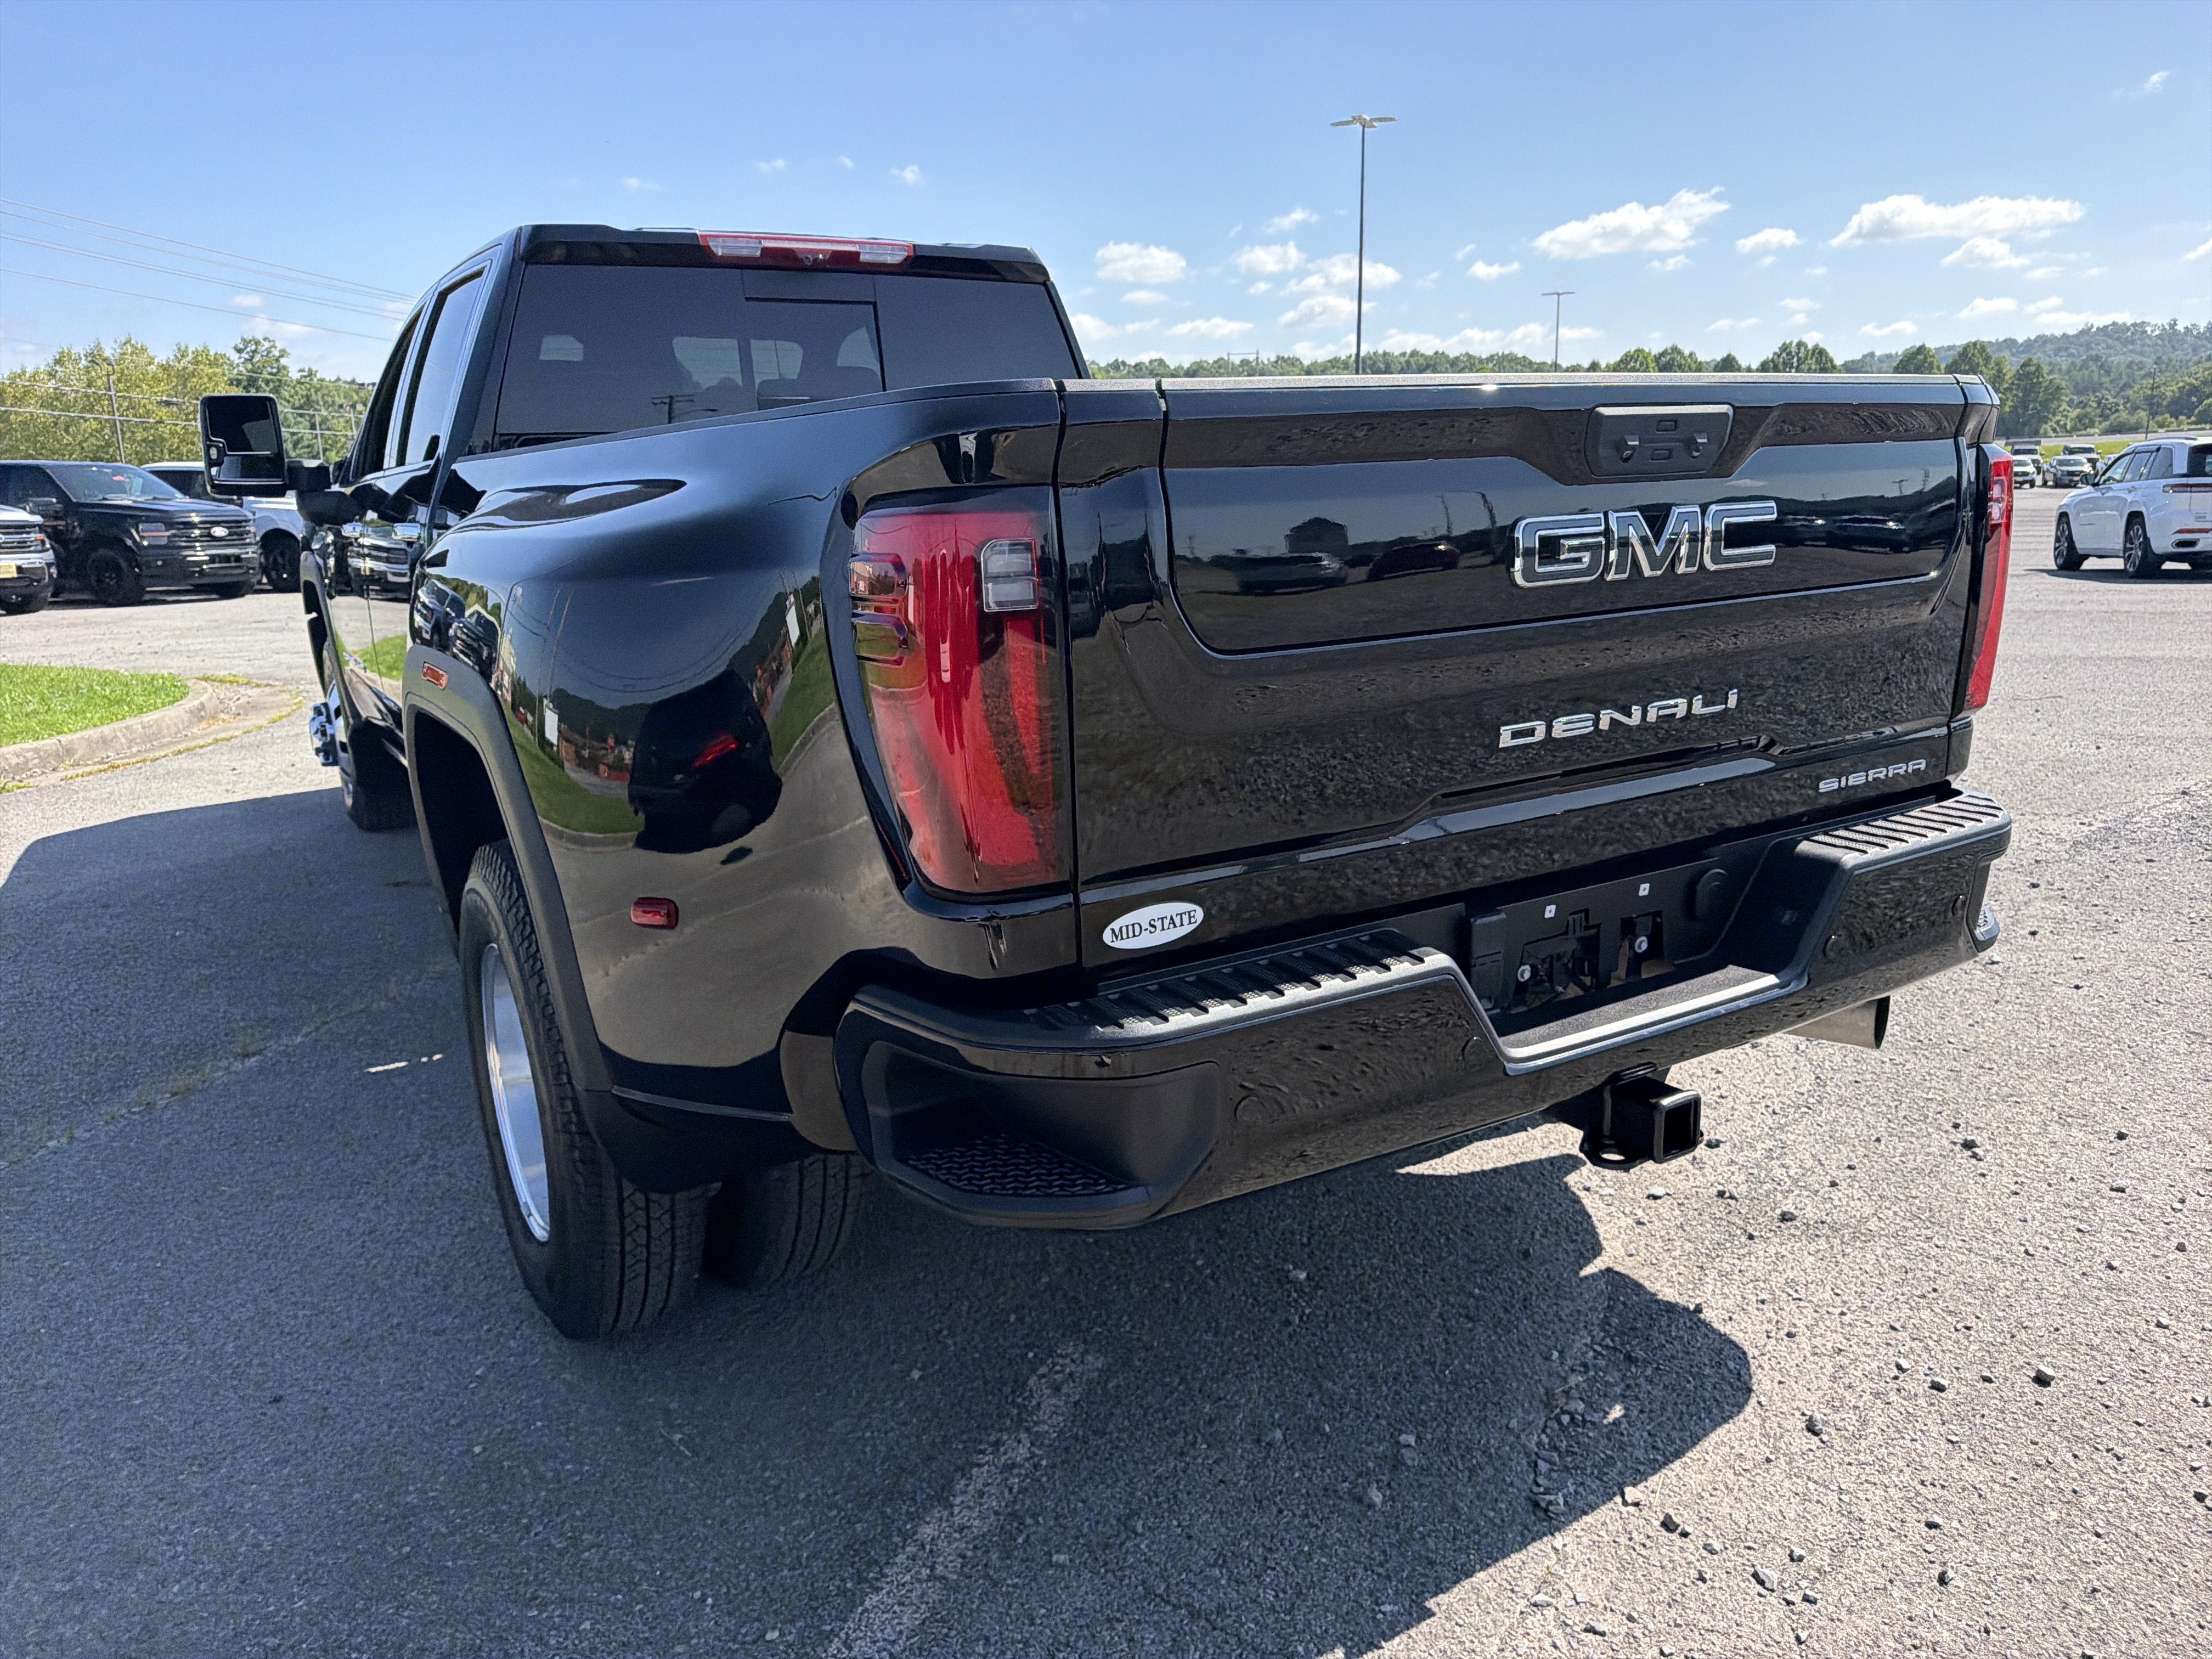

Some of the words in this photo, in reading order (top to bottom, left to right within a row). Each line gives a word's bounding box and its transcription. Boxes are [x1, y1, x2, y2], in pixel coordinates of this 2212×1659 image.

[1511, 500, 1776, 587] GMC
[1498, 689, 1738, 748] DENALI
[1818, 759, 1926, 793] SIERRA
[1110, 909, 1198, 943] MID-STATE
